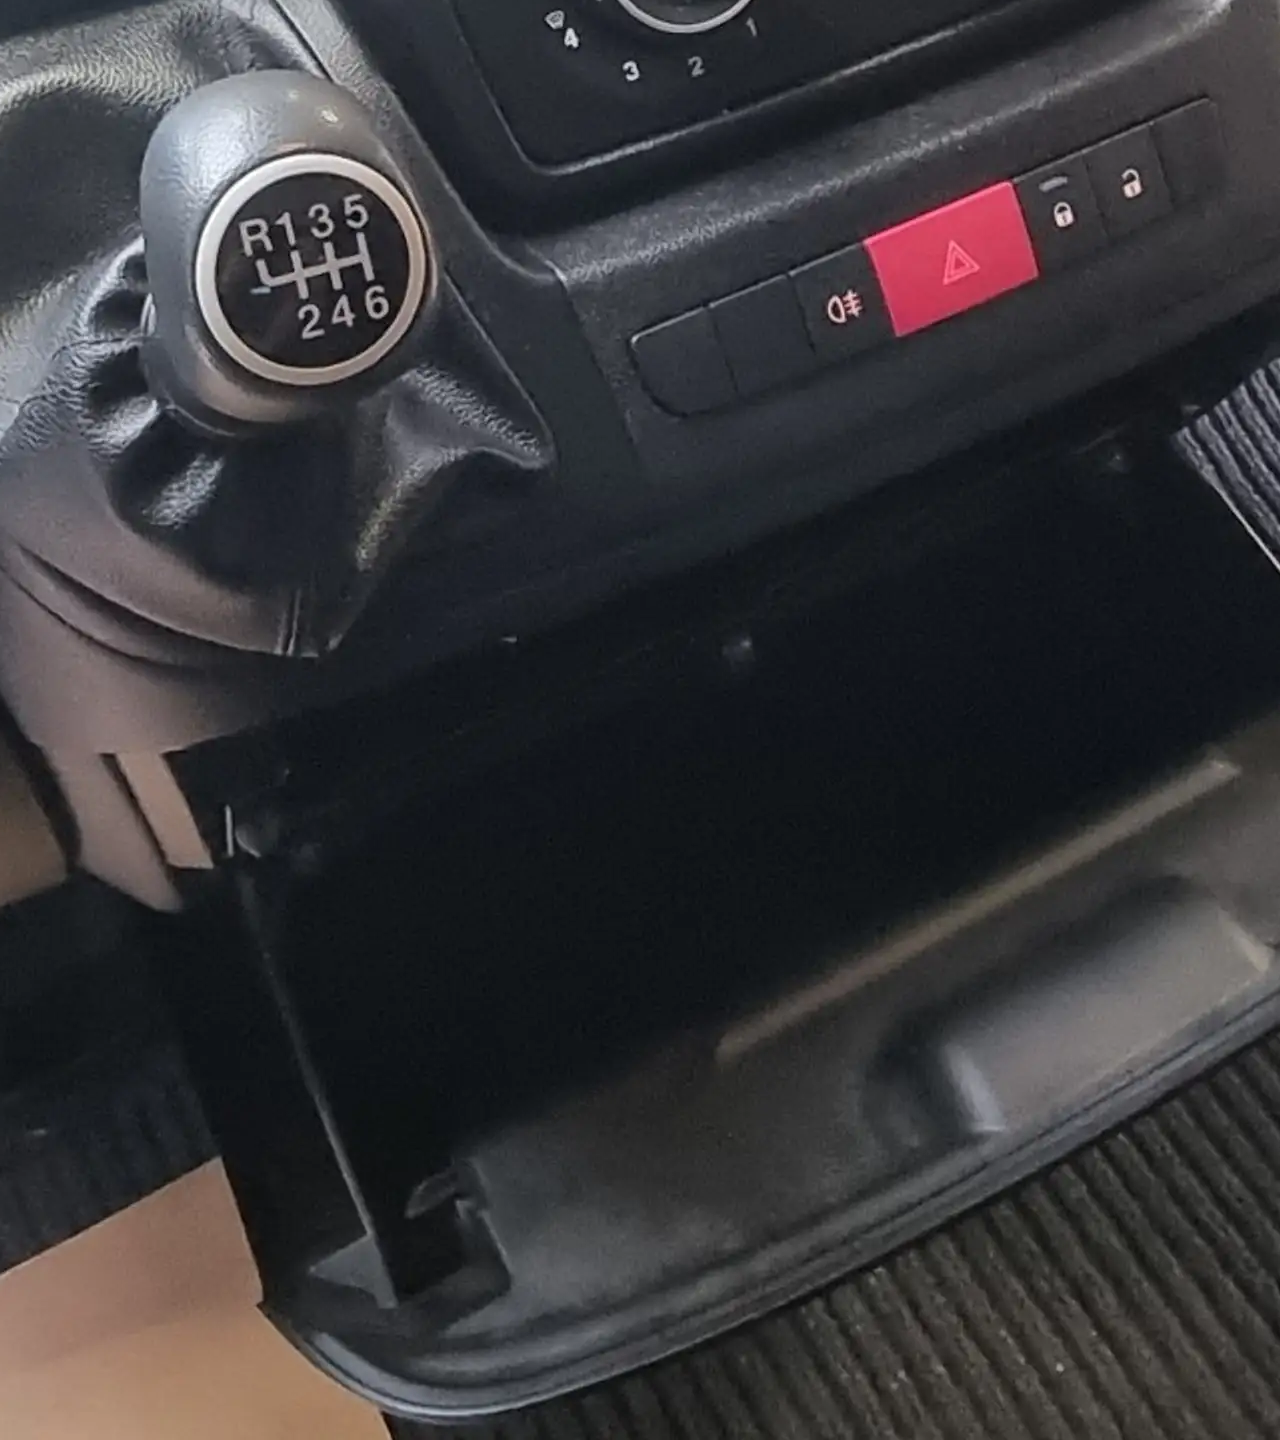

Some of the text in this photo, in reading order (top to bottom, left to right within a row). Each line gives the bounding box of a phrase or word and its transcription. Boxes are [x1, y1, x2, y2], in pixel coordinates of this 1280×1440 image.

[563, 16, 758, 82] 4 3 2 1
